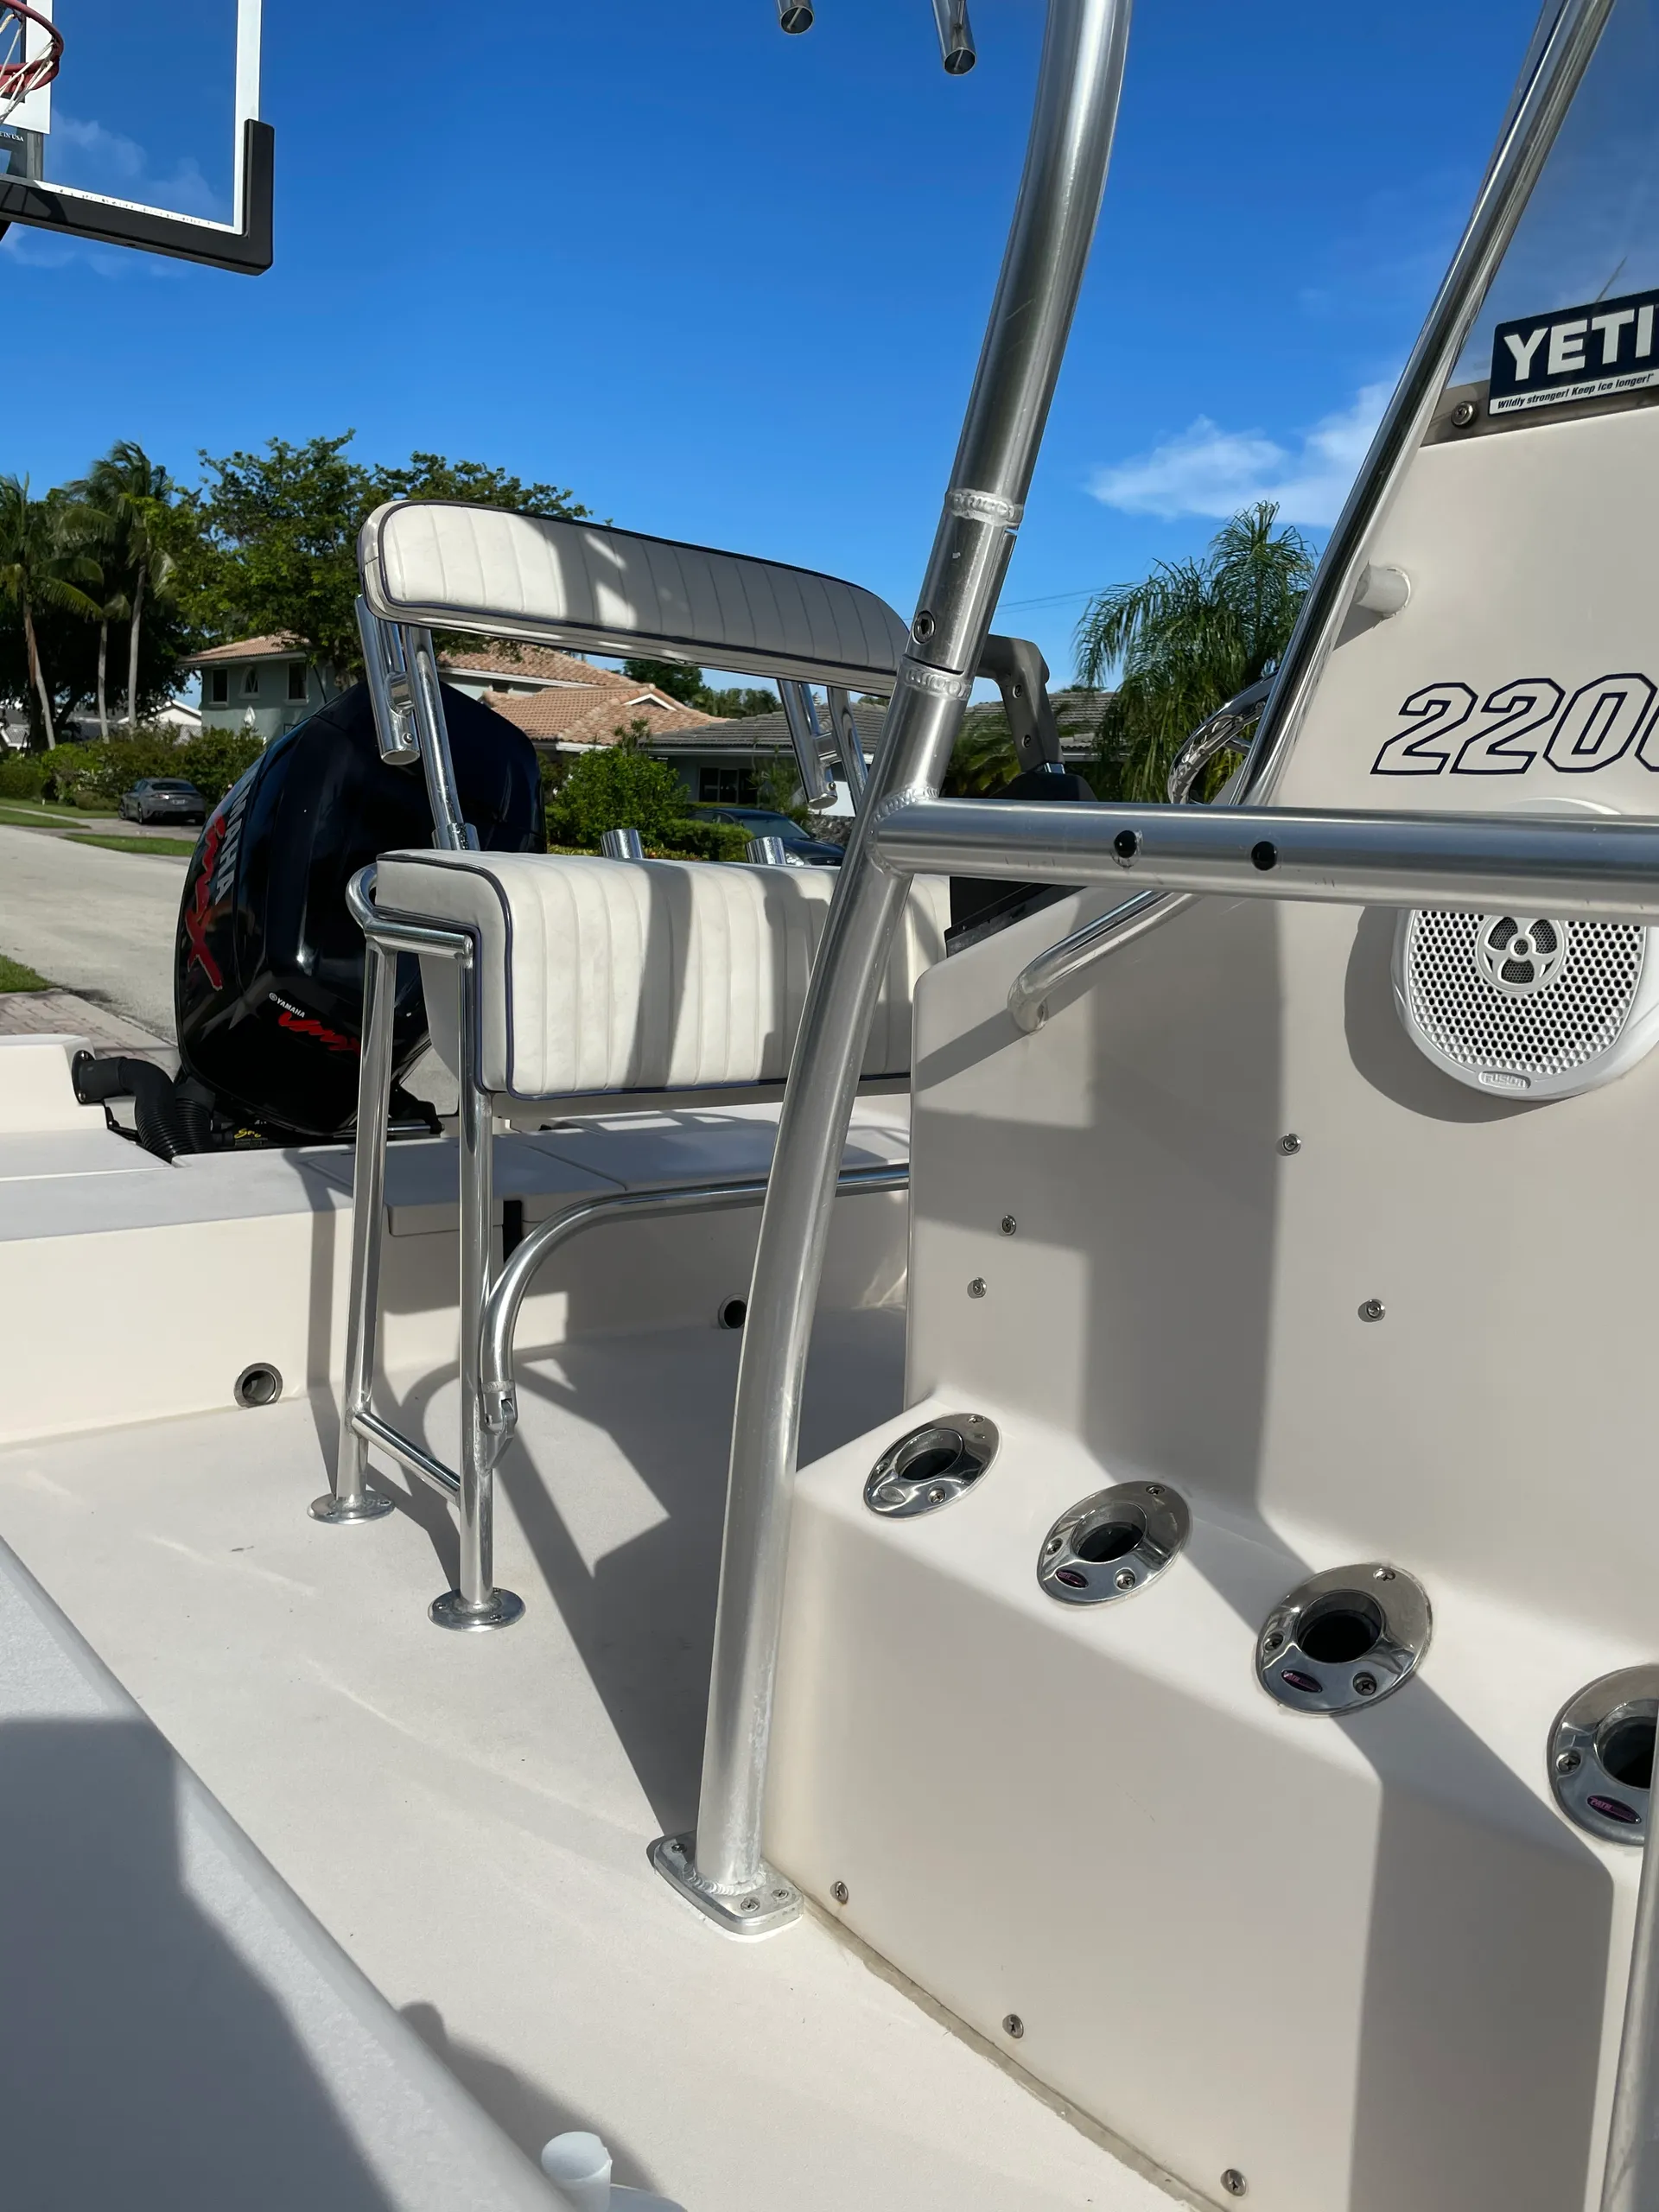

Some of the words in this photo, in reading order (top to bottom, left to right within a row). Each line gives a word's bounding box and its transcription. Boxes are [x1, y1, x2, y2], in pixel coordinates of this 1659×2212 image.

[1503, 304, 1655, 382] YETI
[1497, 397, 1525, 410] Wildly
[1527, 389, 1568, 404] stronger!
[1571, 385, 1596, 396] Keep
[1598, 381, 1614, 391] ice
[1370, 672, 1659, 774] 220
[276, 998, 306, 1018] YAMAHA
